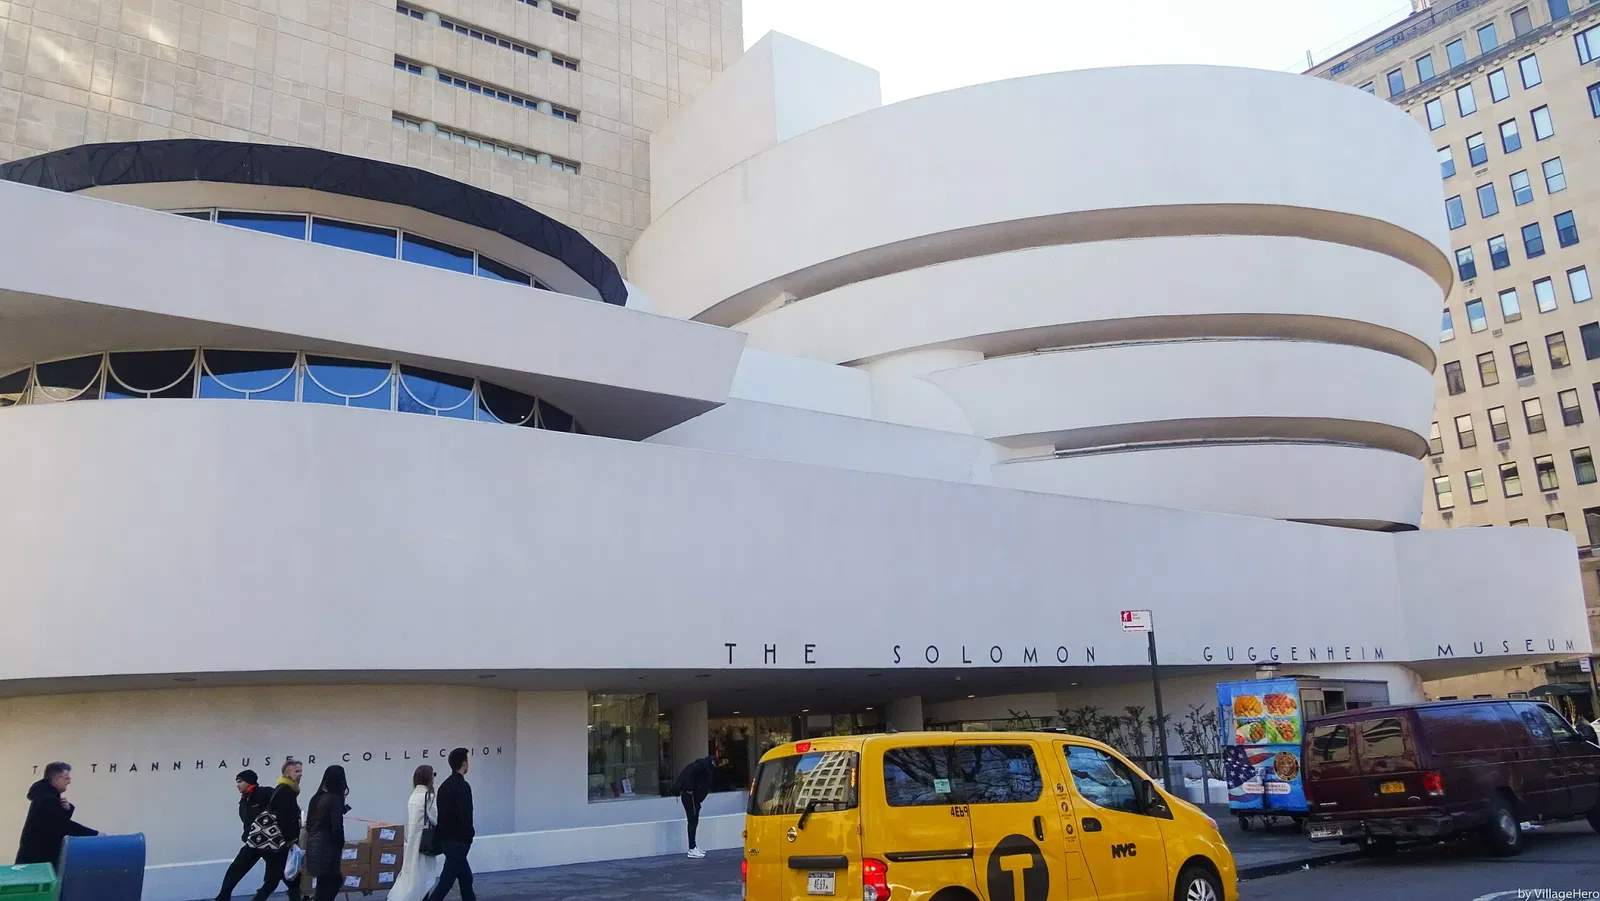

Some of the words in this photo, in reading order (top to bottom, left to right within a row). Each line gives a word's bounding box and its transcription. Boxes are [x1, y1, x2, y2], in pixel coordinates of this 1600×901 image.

[724, 643, 816, 664] THE
[893, 645, 1095, 664] SOLOMON
[1203, 646, 1384, 662] GUGGENHEIM
[1437, 639, 1575, 657] MUSEUM
[342, 746, 502, 762] COLLECION
[1111, 843, 1137, 859] NYC
[1000, 853, 1034, 901] T
